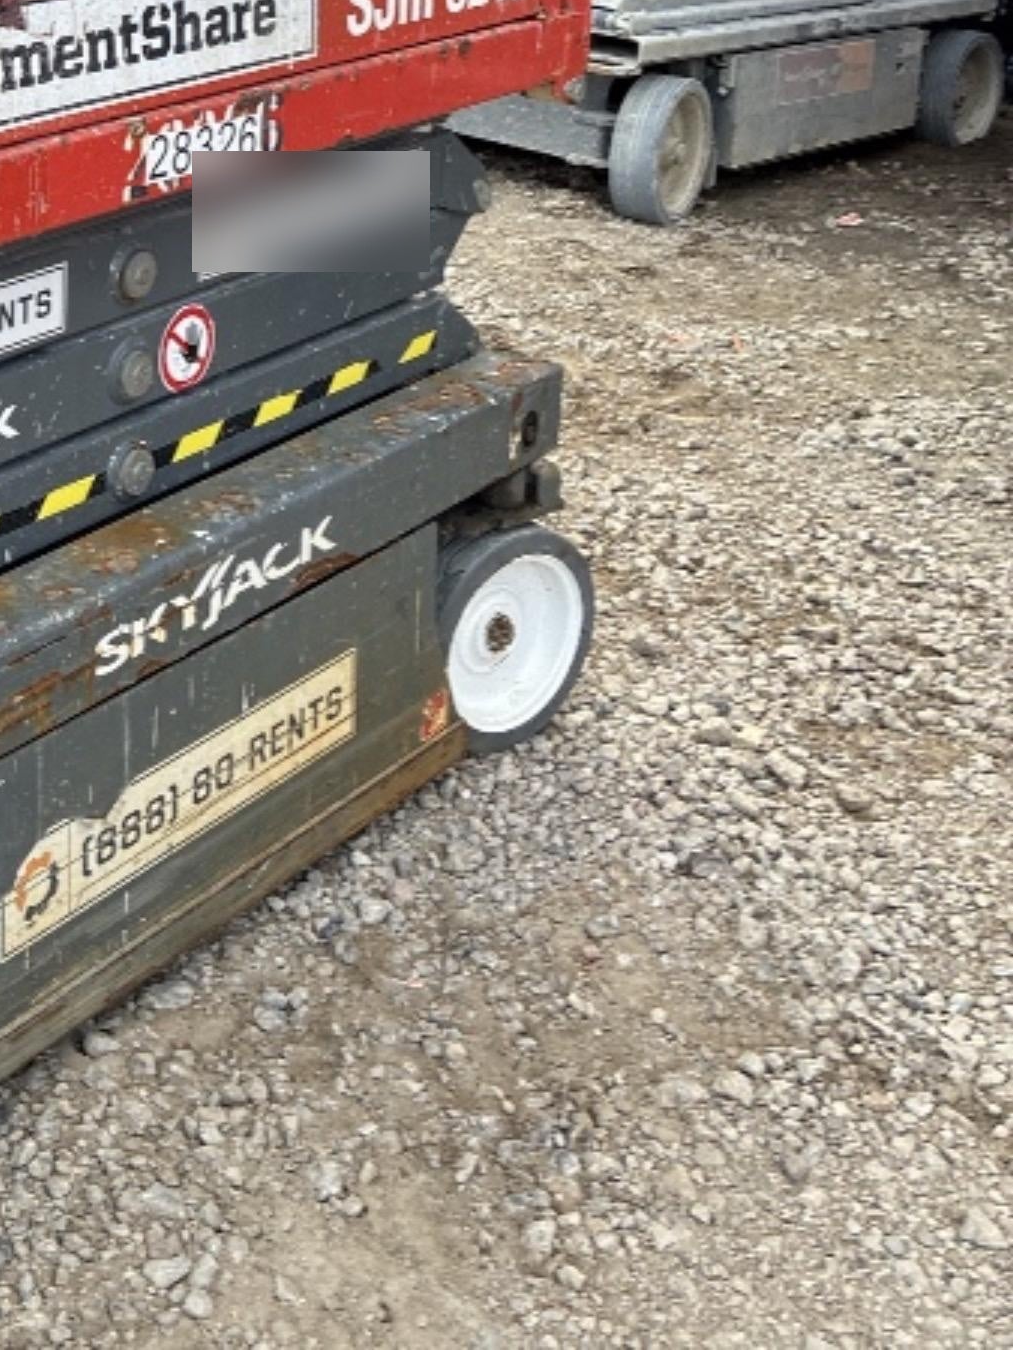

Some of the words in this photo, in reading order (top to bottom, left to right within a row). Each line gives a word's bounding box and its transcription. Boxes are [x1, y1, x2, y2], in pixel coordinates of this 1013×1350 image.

[94, 516, 337, 676] SKYJACK
[81, 784, 180, 878] (888)
[192, 685, 345, 803] 80-RENTS
